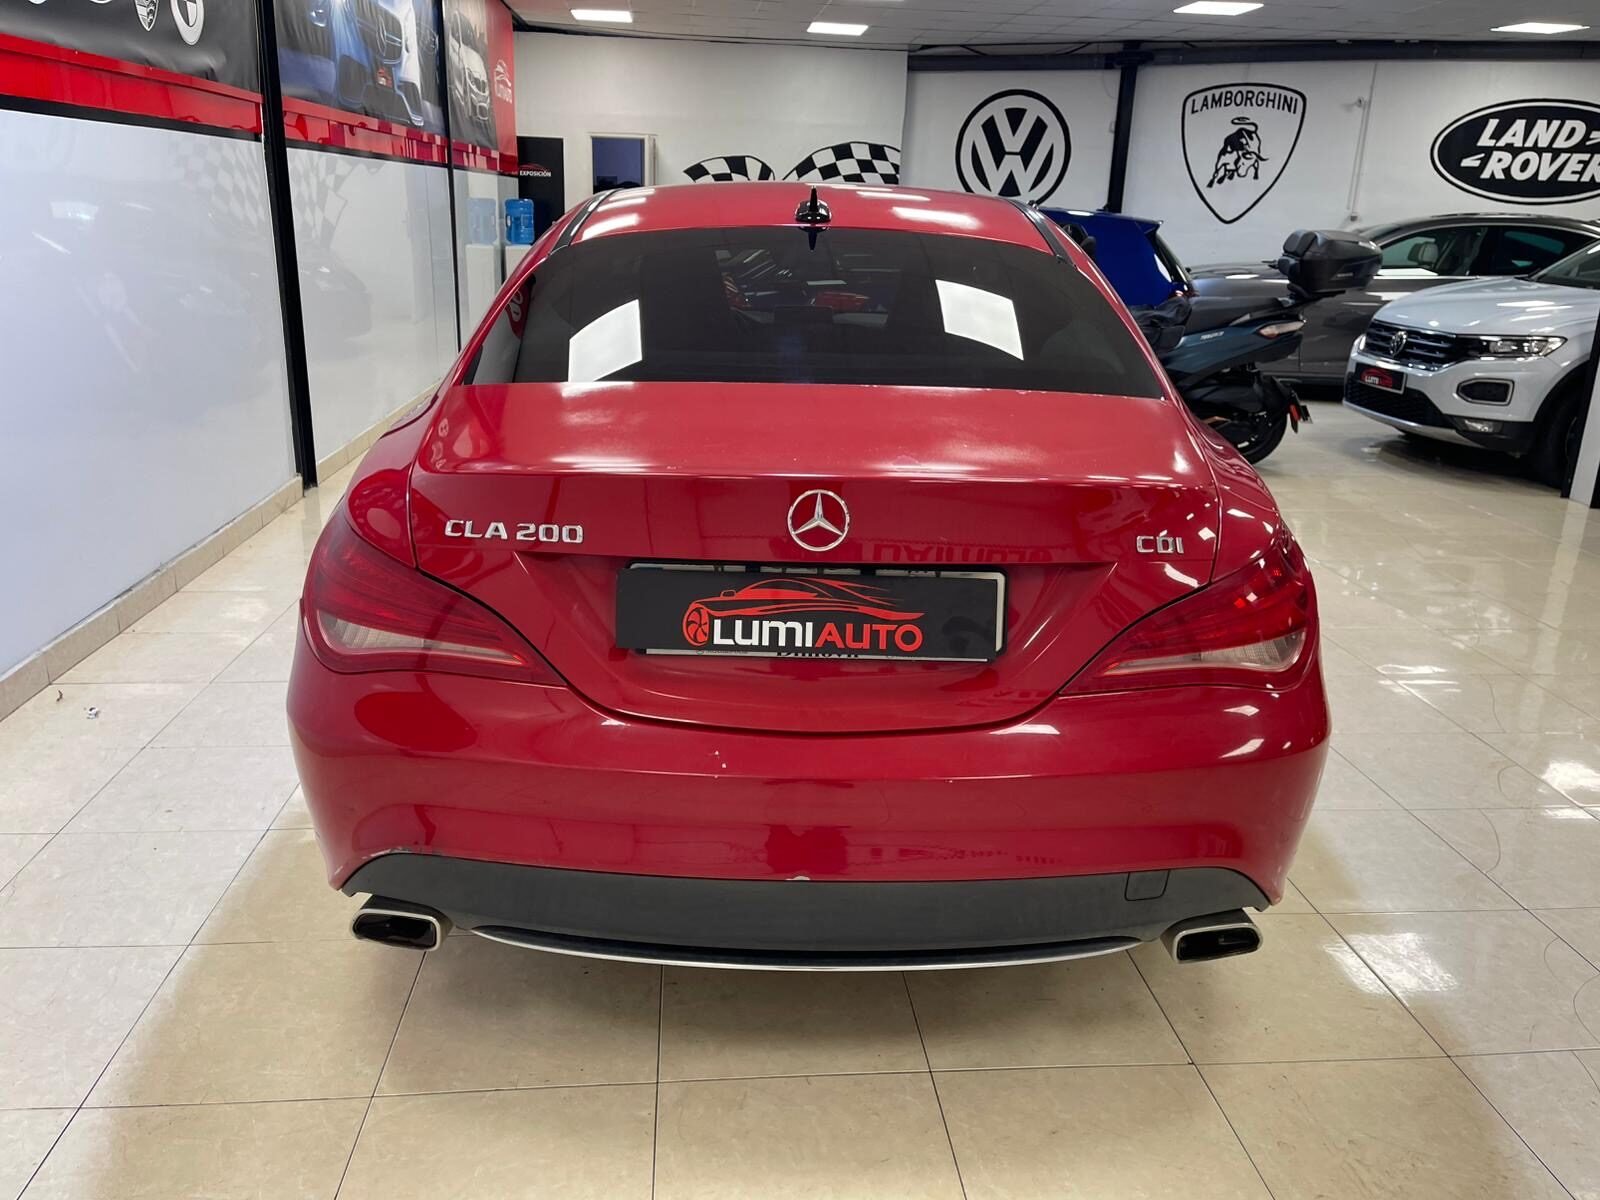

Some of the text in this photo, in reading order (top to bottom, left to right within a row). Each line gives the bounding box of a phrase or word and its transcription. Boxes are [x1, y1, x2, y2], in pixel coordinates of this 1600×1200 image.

[1190, 89, 1298, 115] LAMBORGHINI
[1476, 118, 1587, 149] LAND
[444, 519, 584, 544] CLA 200
